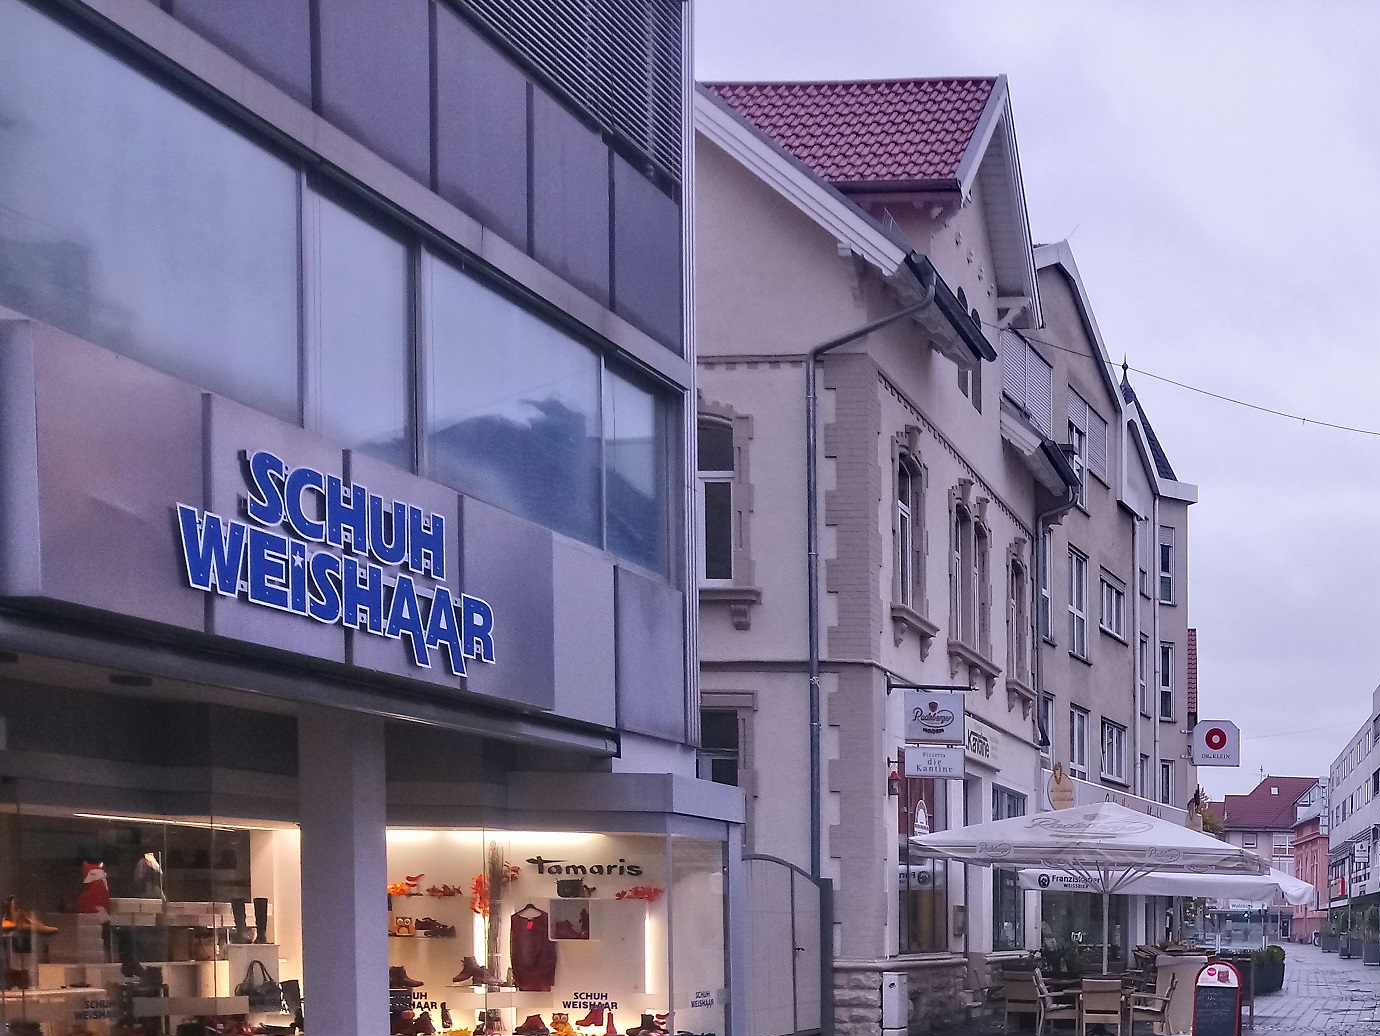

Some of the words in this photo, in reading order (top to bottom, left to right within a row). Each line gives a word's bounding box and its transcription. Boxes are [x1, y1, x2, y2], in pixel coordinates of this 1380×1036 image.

[247, 451, 446, 581] SCHUH
[176, 502, 496, 677] WEISHAAR
[927, 758, 942, 766] die
[916, 764, 953, 773] Kantine
[573, 992, 608, 1000] SCHUH
